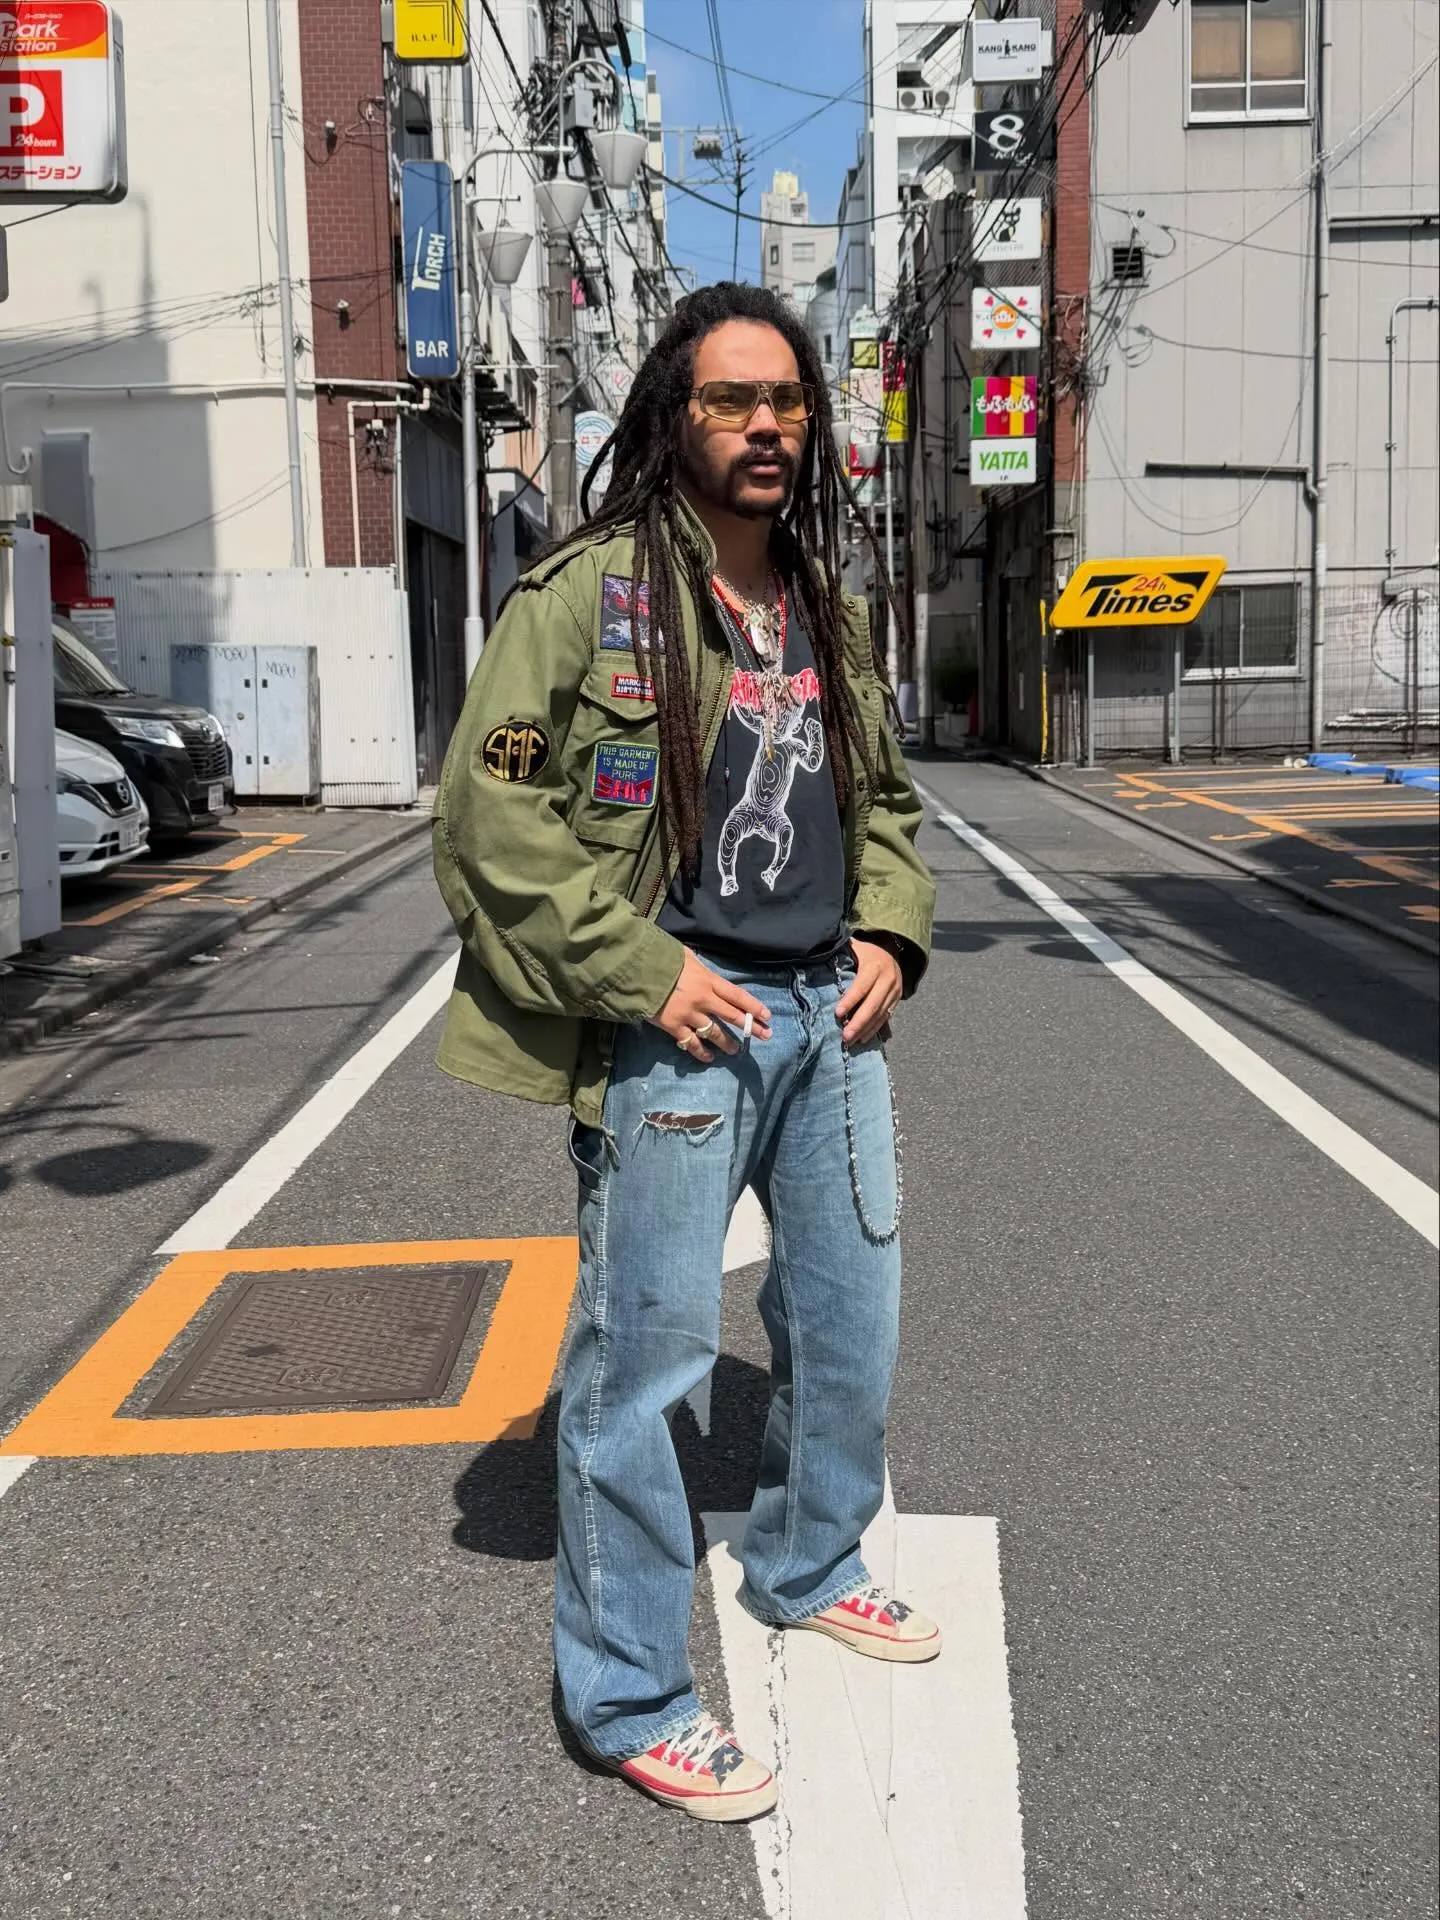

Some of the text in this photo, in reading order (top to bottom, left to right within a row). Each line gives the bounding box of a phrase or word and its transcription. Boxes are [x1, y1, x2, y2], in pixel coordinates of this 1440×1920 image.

[2, 20, 60, 39] Park
[0, 40, 57, 52] station
[978, 43, 1037, 54] KANG KANG
[0, 83, 46, 147] P
[988, 113, 1025, 152] 8
[411, 226, 446, 292] TORCH
[415, 340, 449, 358] BAR
[979, 451, 1029, 470] YATTA
[1085, 586, 1195, 618] Times
[600, 745, 657, 760] THIS GARMENT
[603, 757, 649, 770] IS MADE OF
[611, 769, 638, 781] PURE
